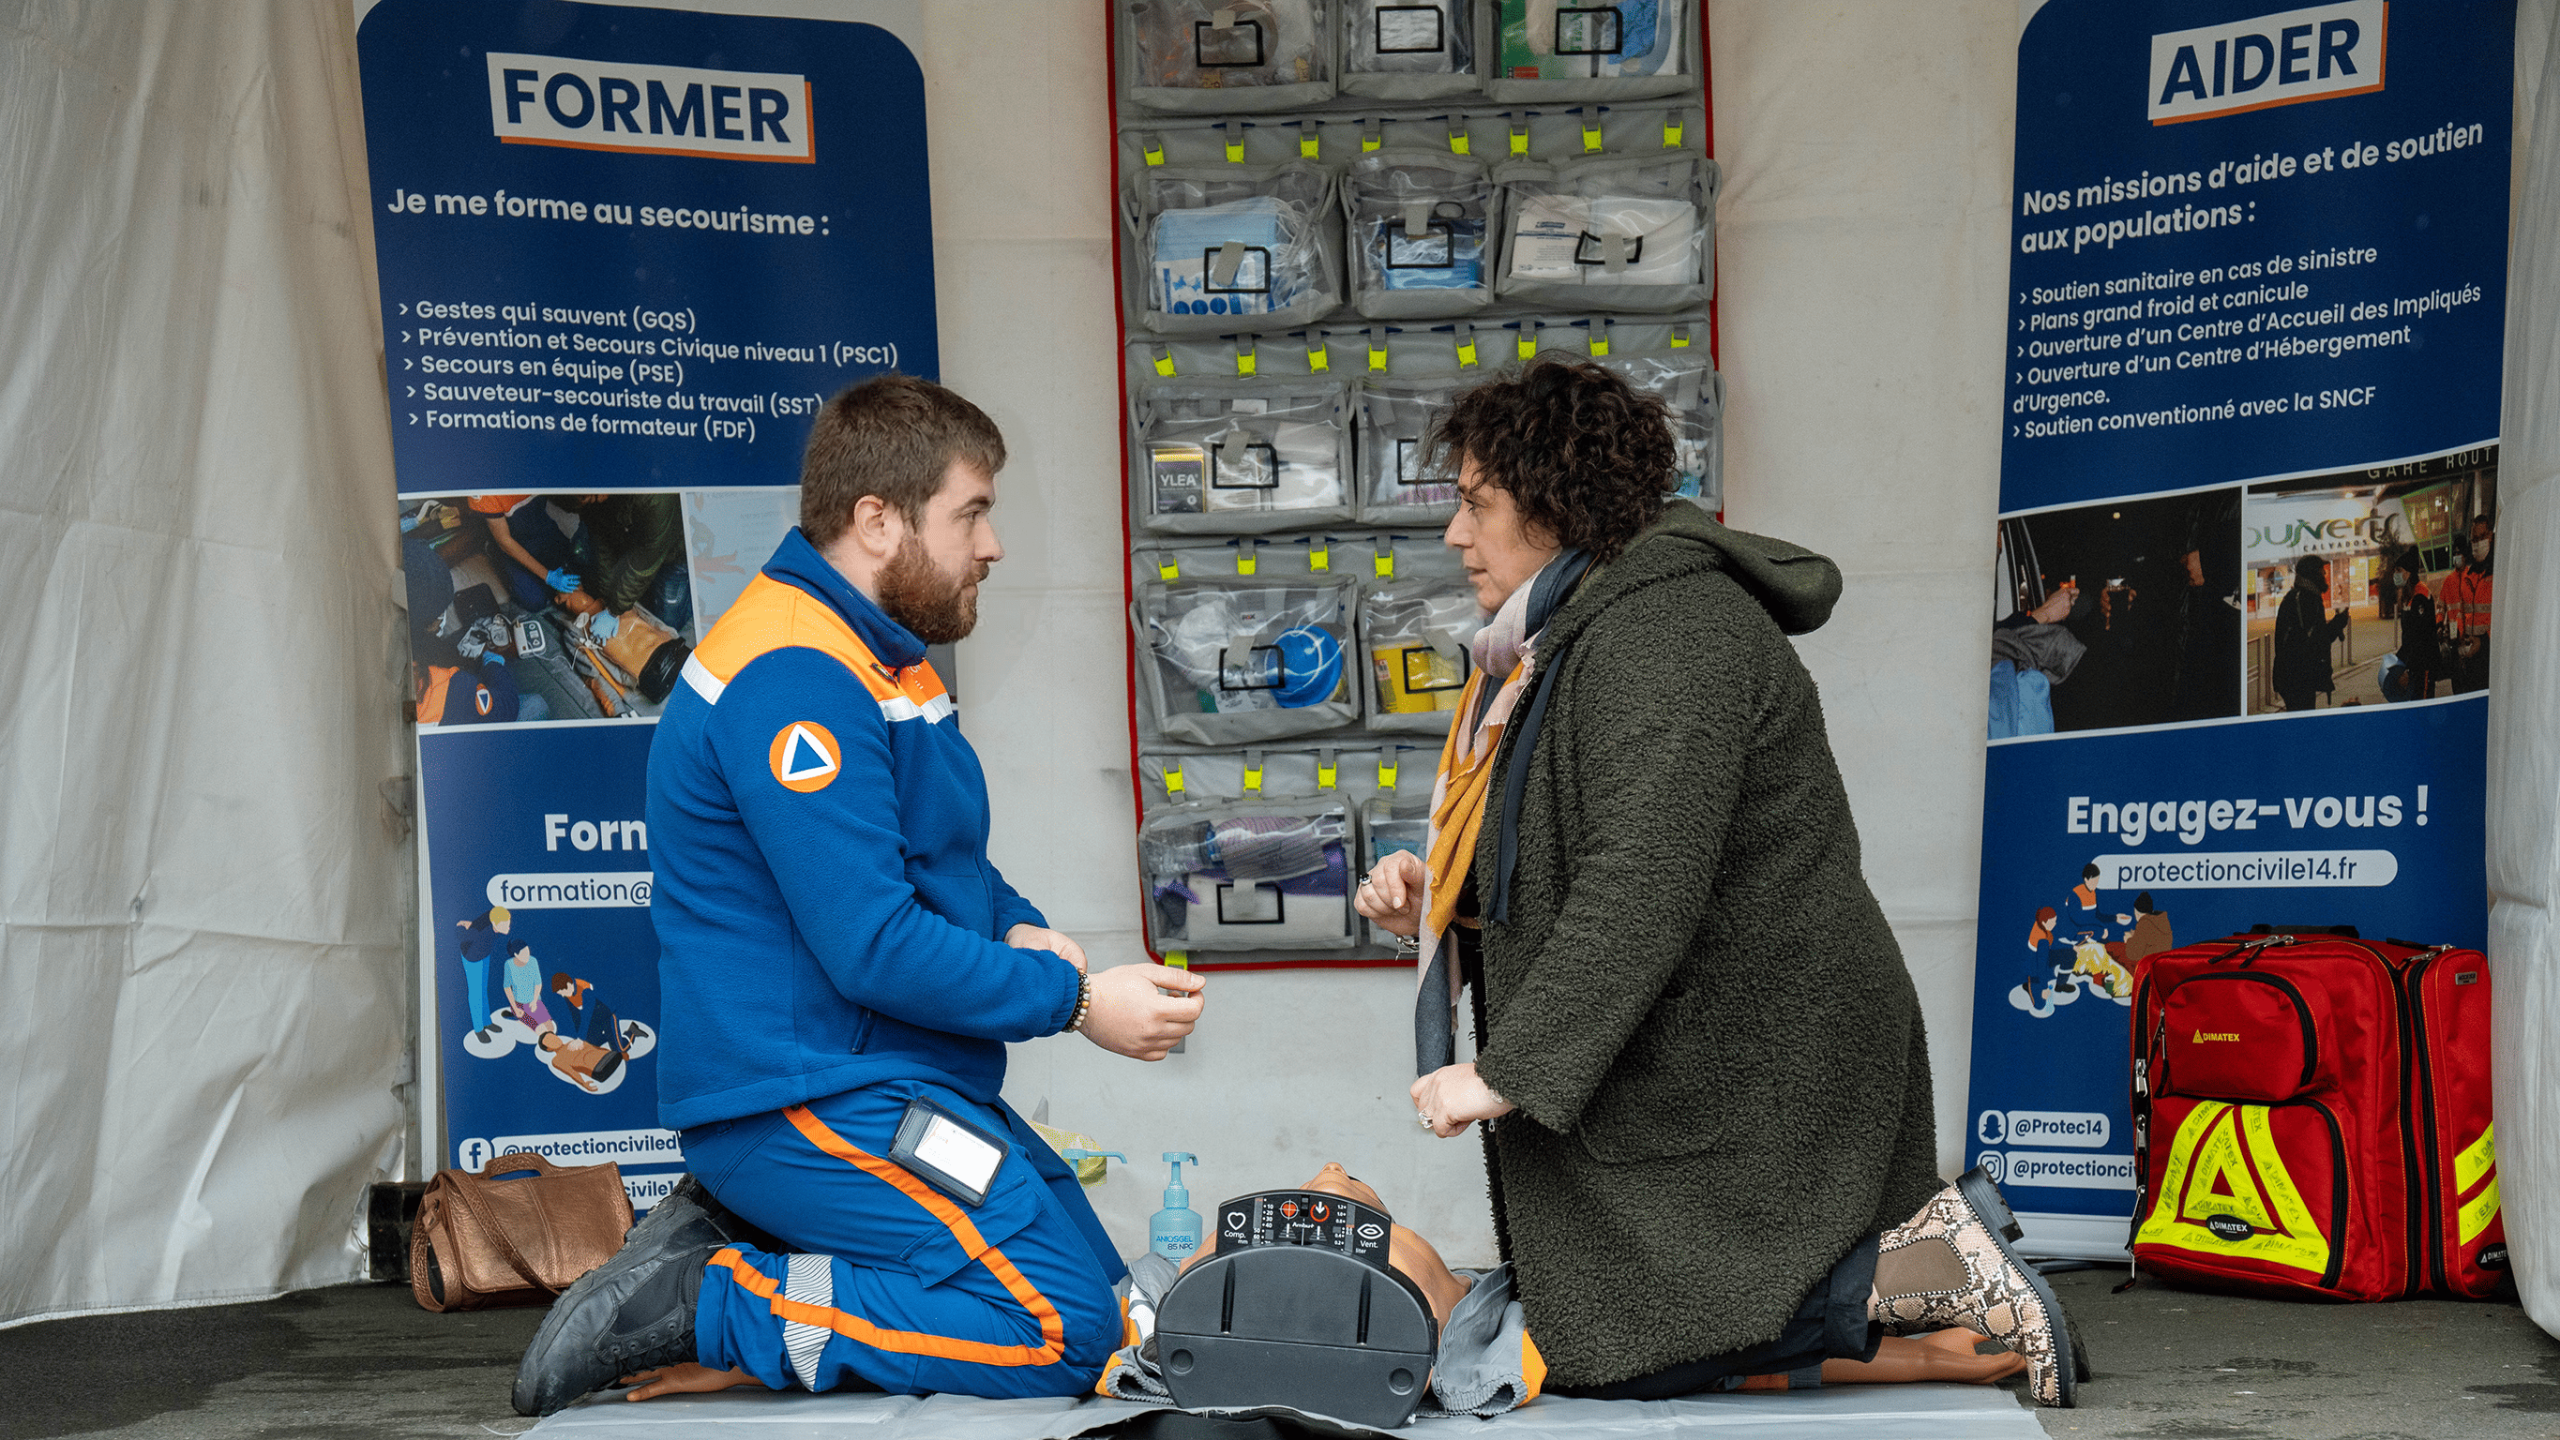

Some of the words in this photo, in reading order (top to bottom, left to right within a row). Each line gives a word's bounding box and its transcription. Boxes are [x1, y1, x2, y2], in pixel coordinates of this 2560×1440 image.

[2159, 18, 2360, 106] AIDER
[503, 67, 792, 144] FORMER
[2023, 190, 2071, 216] Nos
[2076, 170, 2202, 211] missions
[2303, 146, 2335, 174] et
[2341, 141, 2380, 169] de
[2385, 121, 2483, 163] soutien
[387, 188, 427, 214] Je
[434, 194, 488, 216] me
[493, 189, 588, 222] forme
[593, 203, 633, 225] au
[640, 205, 815, 235] secourisme
[2021, 228, 2069, 254] aux
[2073, 203, 2243, 255] populations
[2032, 280, 2100, 305] Soutien
[2104, 268, 2195, 295] sanitaire
[2199, 267, 2224, 285] en
[2227, 261, 2262, 281] cas
[2266, 254, 2293, 275] de
[2298, 247, 2378, 271] sinistre
[416, 300, 496, 320] Gestes
[501, 301, 537, 327] qui
[542, 307, 628, 327] sauvent
[632, 305, 696, 335] (GQS)
[2029, 333, 2122, 358] Ouverture
[2177, 319, 2244, 342] Centre
[2350, 301, 2389, 322] des
[2393, 282, 2481, 319] Impliqués
[2030, 312, 2079, 332] Plans
[2083, 301, 2143, 331] grand
[2147, 294, 2195, 318] froid
[2199, 292, 2219, 312] et
[2222, 280, 2309, 309] canicule
[418, 326, 542, 349] Prévention
[547, 332, 569, 350] et
[572, 333, 656, 356] Secours
[660, 337, 740, 364] Civique
[744, 341, 815, 363] niveau
[833, 340, 898, 369] (PSC1)
[2027, 360, 2121, 385] Ouverture
[2176, 347, 2242, 369] Centre
[421, 355, 514, 375] Secours
[519, 360, 547, 376] en
[551, 357, 624, 385] équipe
[629, 358, 684, 388] (PSE)
[423, 382, 662, 409] Sauveteur-secouriste
[666, 391, 695, 410] du
[698, 393, 764, 414] travail
[2025, 414, 2093, 439] Soutien
[2097, 398, 2236, 431] conventionné
[2239, 398, 2289, 417] avec
[2294, 392, 2314, 412] la
[2319, 386, 2376, 409] SNCF
[426, 409, 556, 431] Formations
[560, 412, 587, 432] de
[591, 413, 698, 437] formateur
[704, 414, 756, 444] (FDF)
[2303, 539, 2368, 553] CALVADOS
[2067, 795, 2403, 847] Engagez-vous
[2118, 857, 2357, 889] protectioncivile14.fr
[2202, 1032, 2240, 1042] DIMATEX
[2015, 1118, 2103, 1137] @Protec14
[1223, 1229, 1246, 1239] Comp.
[1359, 1240, 1379, 1248] Vent.
[2214, 1221, 2248, 1232] DIMATEX
